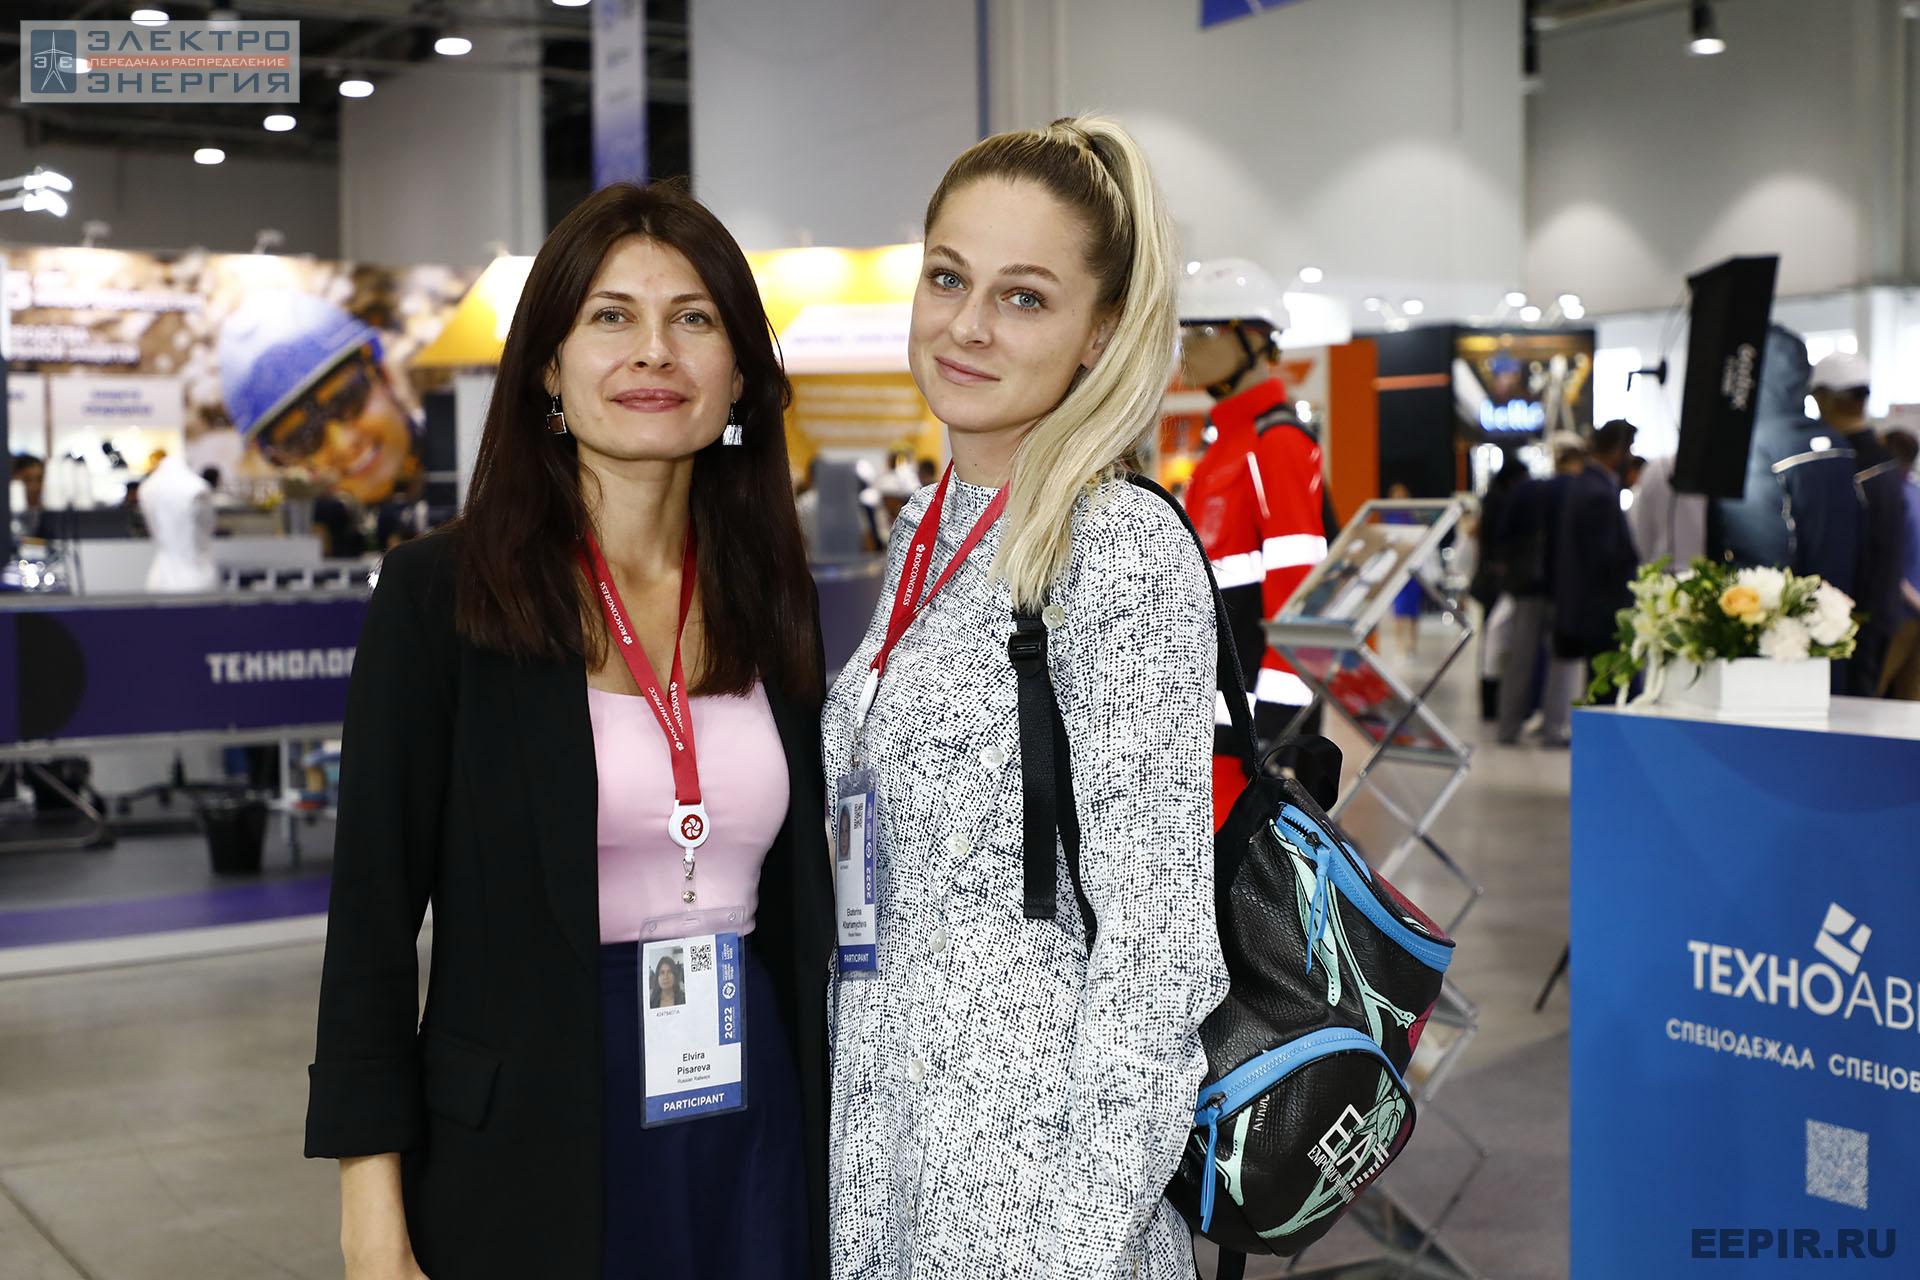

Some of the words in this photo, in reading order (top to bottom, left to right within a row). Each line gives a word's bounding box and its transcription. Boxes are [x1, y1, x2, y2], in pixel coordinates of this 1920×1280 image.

[903, 552, 923, 607] ROSCONGRESS
[600, 581, 630, 637] ROSCONGRESS
[1687, 940, 1920, 1034] ТЕХНОАВ
[724, 1007, 733, 1039] 2022
[682, 1052, 705, 1062] Elvira
[1665, 1018, 1816, 1071] СПЕЦОДЕЖДА
[677, 1063, 711, 1076] Pisareva
[663, 1092, 725, 1112] PARTICIPANT
[1306, 1144, 1343, 1184] EMPORIO
